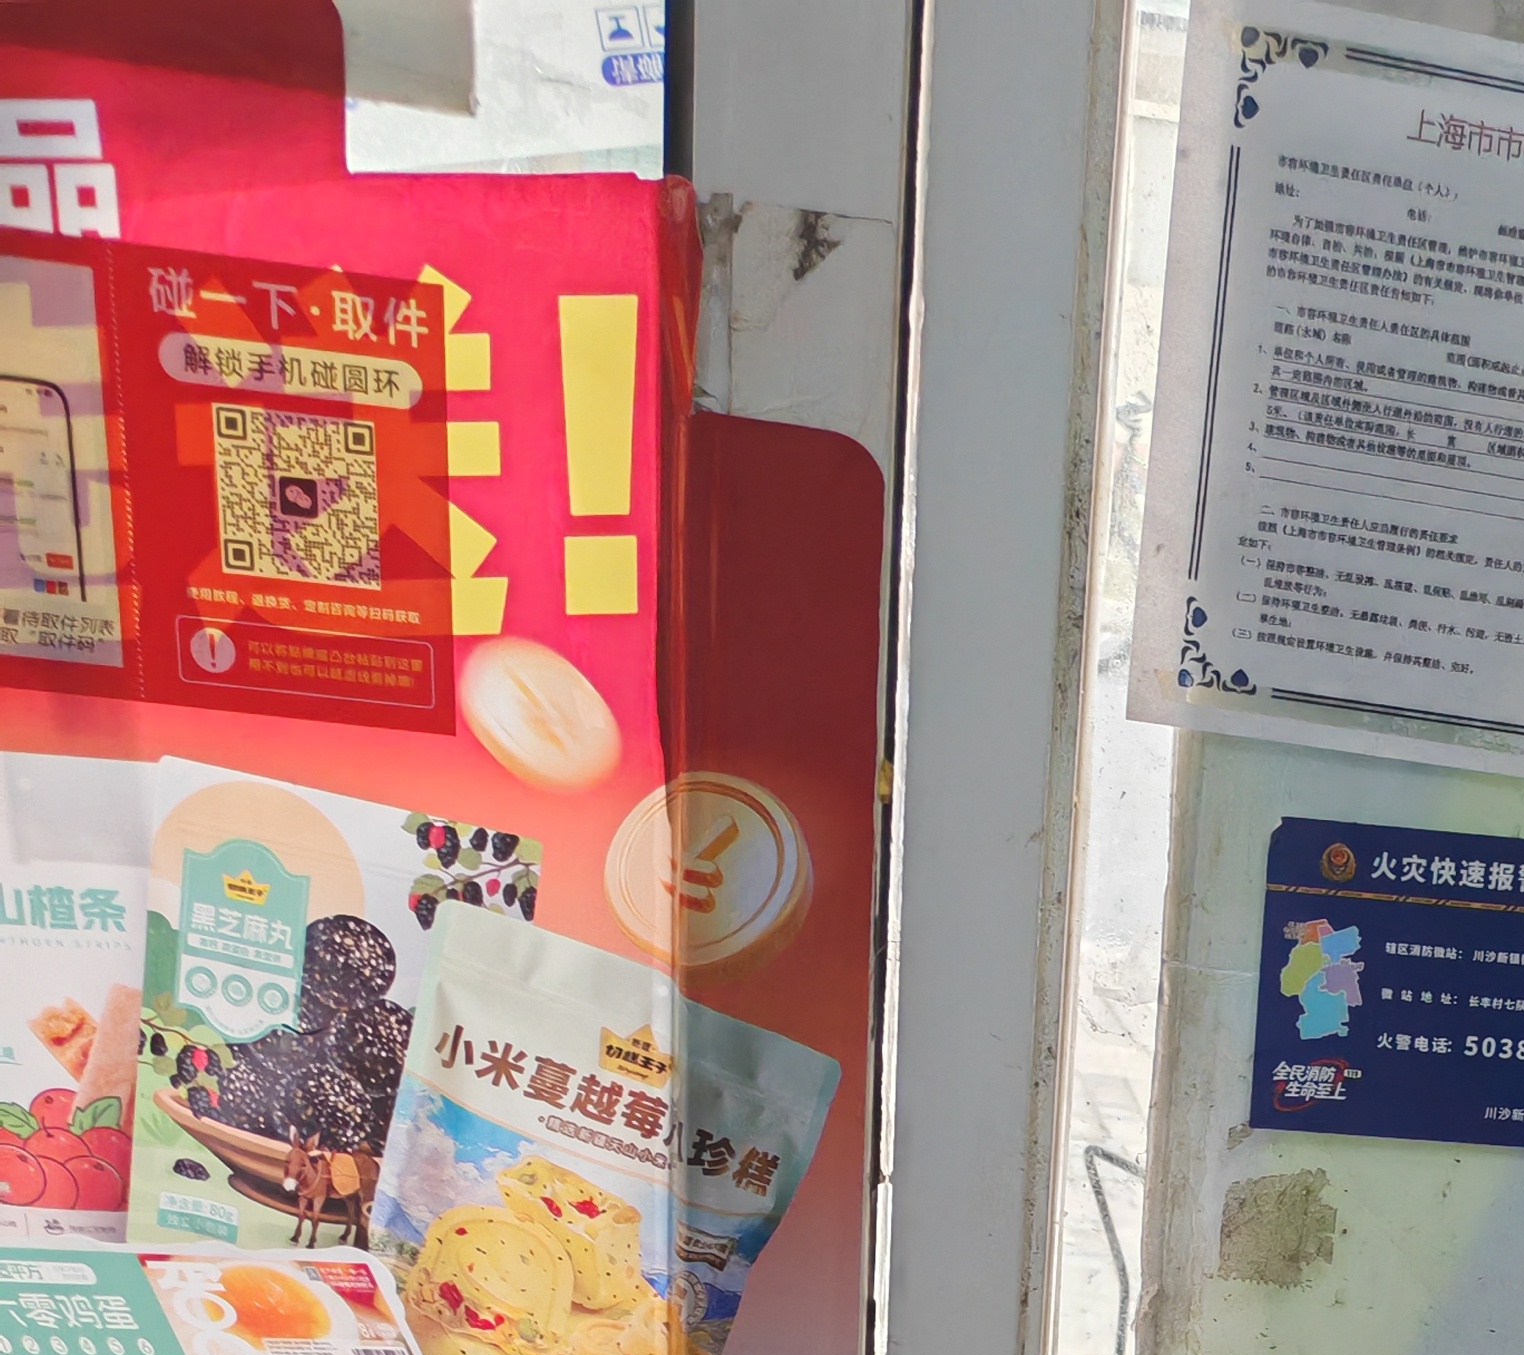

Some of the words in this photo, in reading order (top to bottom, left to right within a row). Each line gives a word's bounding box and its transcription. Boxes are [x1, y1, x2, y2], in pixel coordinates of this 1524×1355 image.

[0, 99, 121, 238] 品
[183, 341, 402, 400] 解锁手机碰圆环
[192, 902, 293, 950] 黑芝麻丸
[1272, 1060, 1337, 1082] 全民消防
[1284, 1081, 1347, 1101] 生命至上
[434, 1024, 780, 1197] 小米蔓越莓八珍糕
